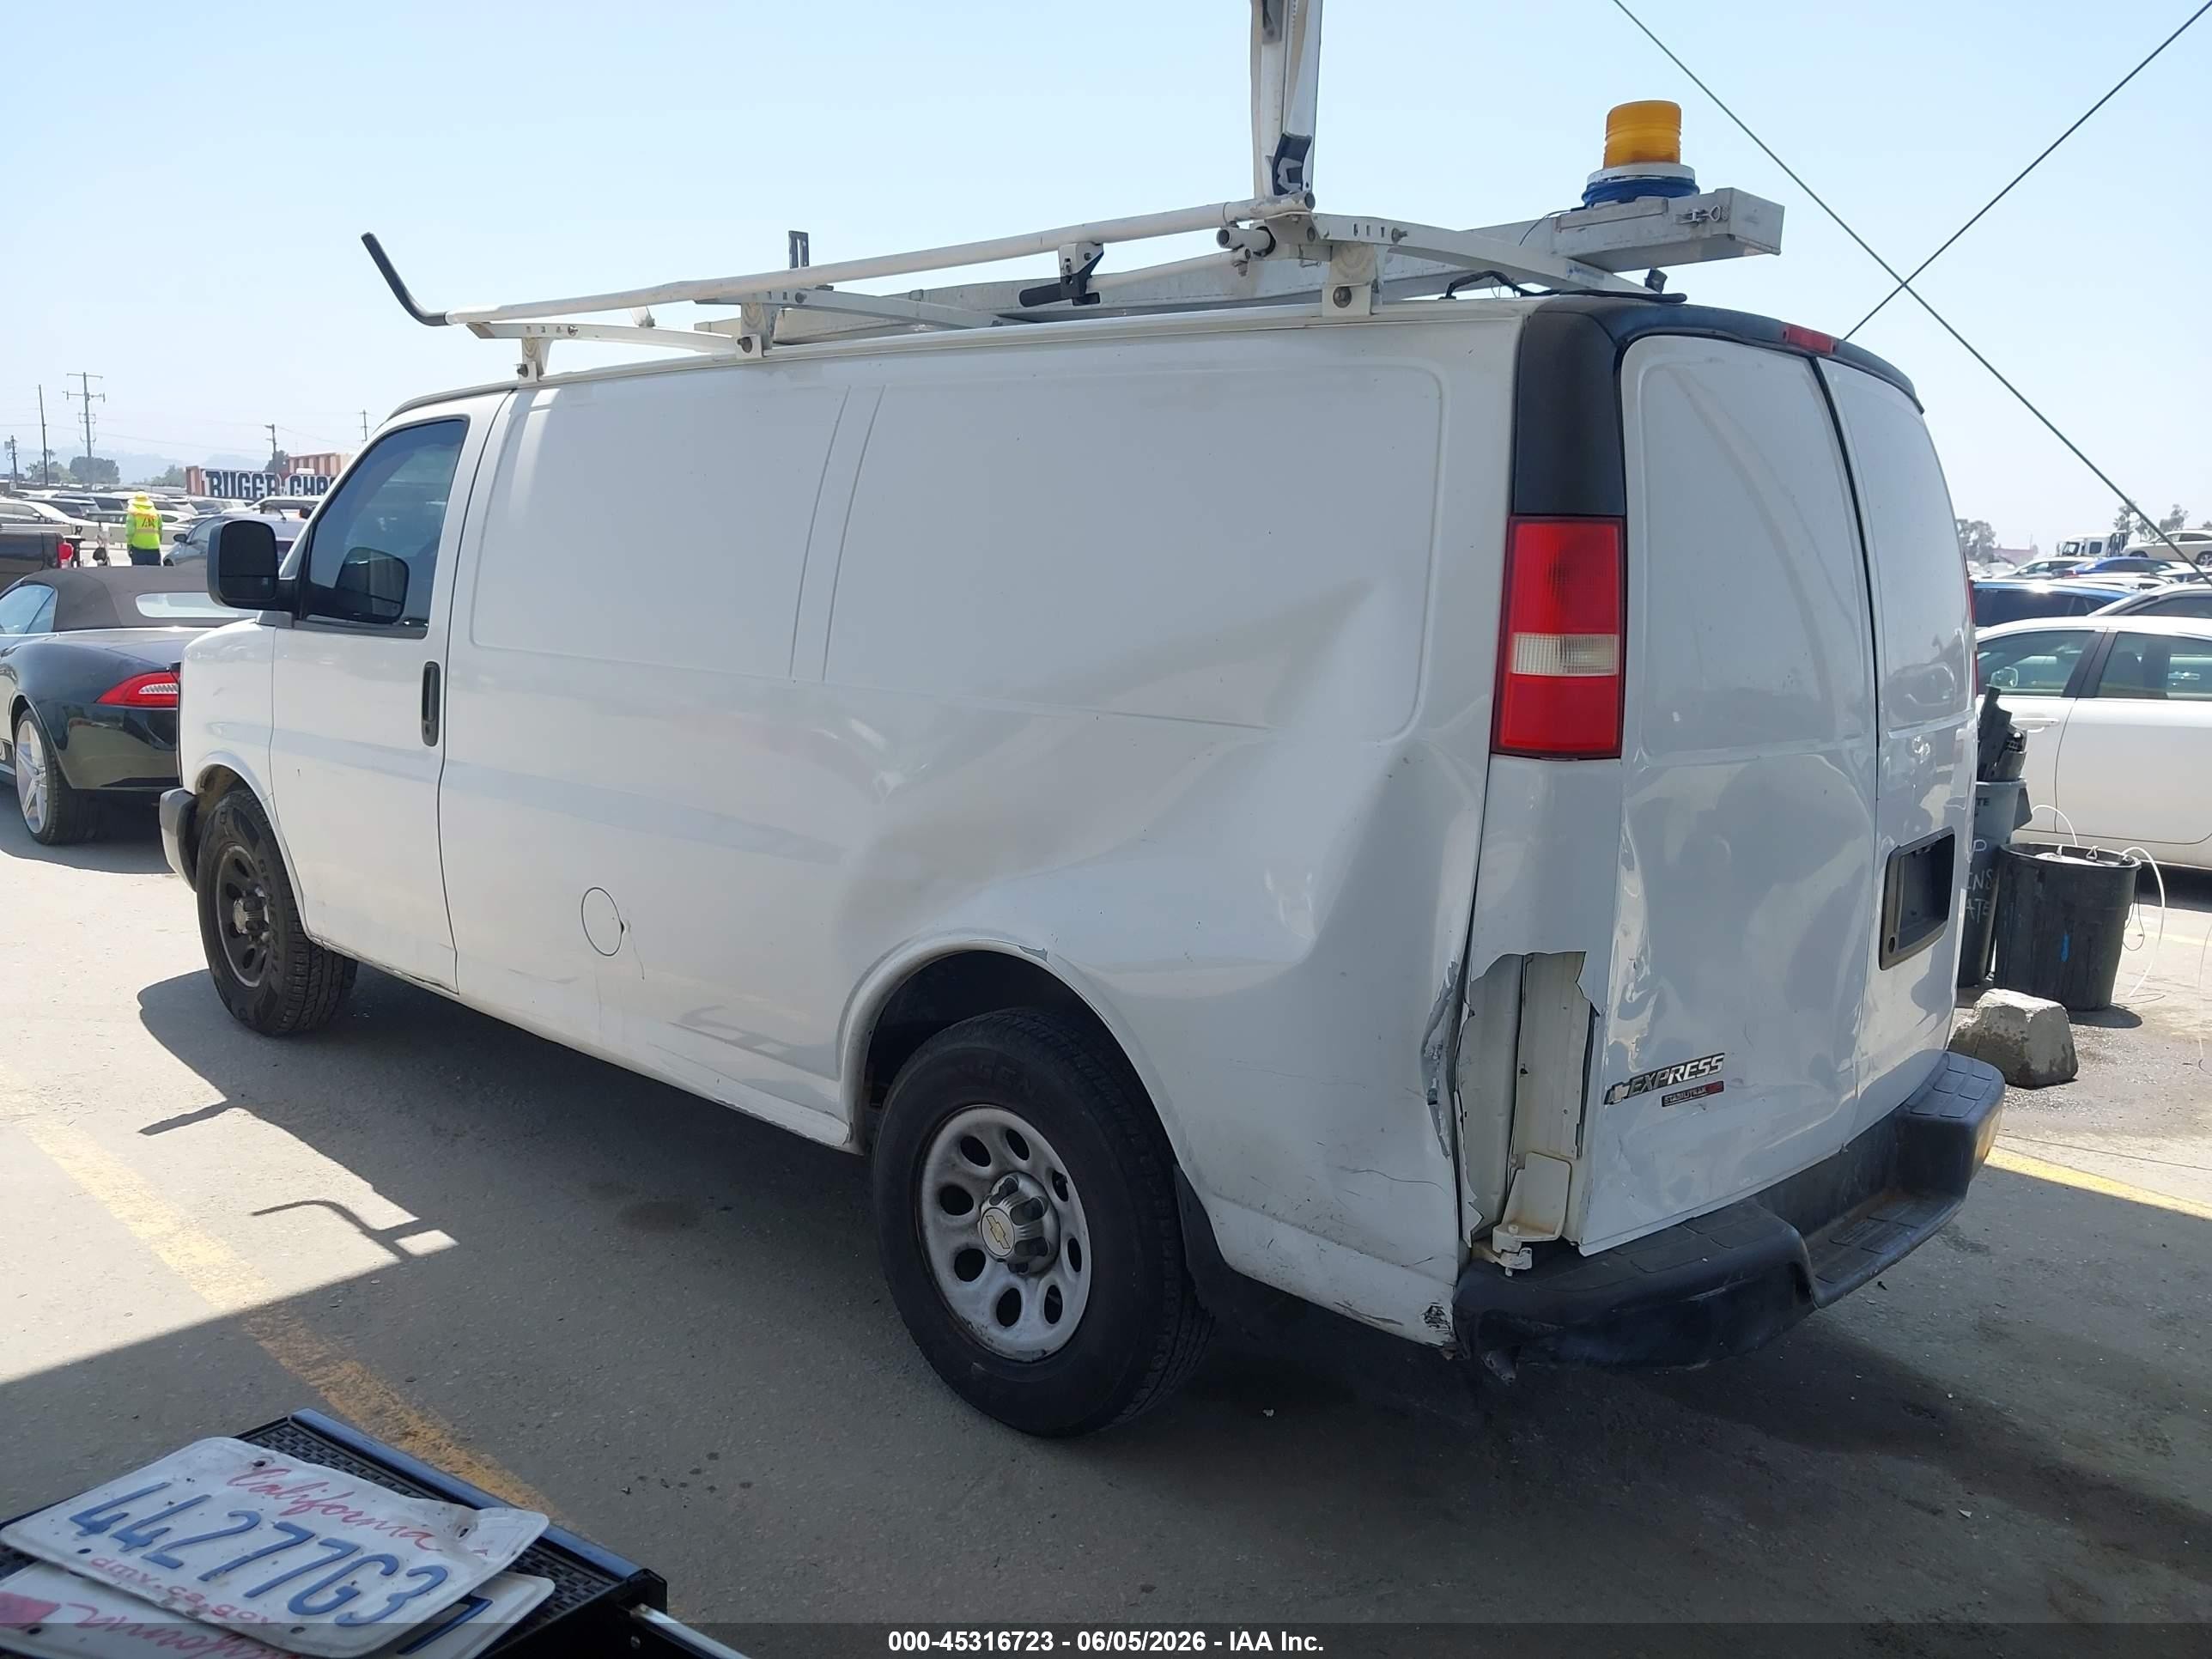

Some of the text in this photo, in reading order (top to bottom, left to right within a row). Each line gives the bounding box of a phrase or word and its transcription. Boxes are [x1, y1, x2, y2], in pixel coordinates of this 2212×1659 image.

[289, 474, 337, 496] CHA
[1628, 1054, 1724, 1097] EXPRESS
[227, 1468, 443, 1552] California
[69, 1481, 449, 1628] 44277G3
